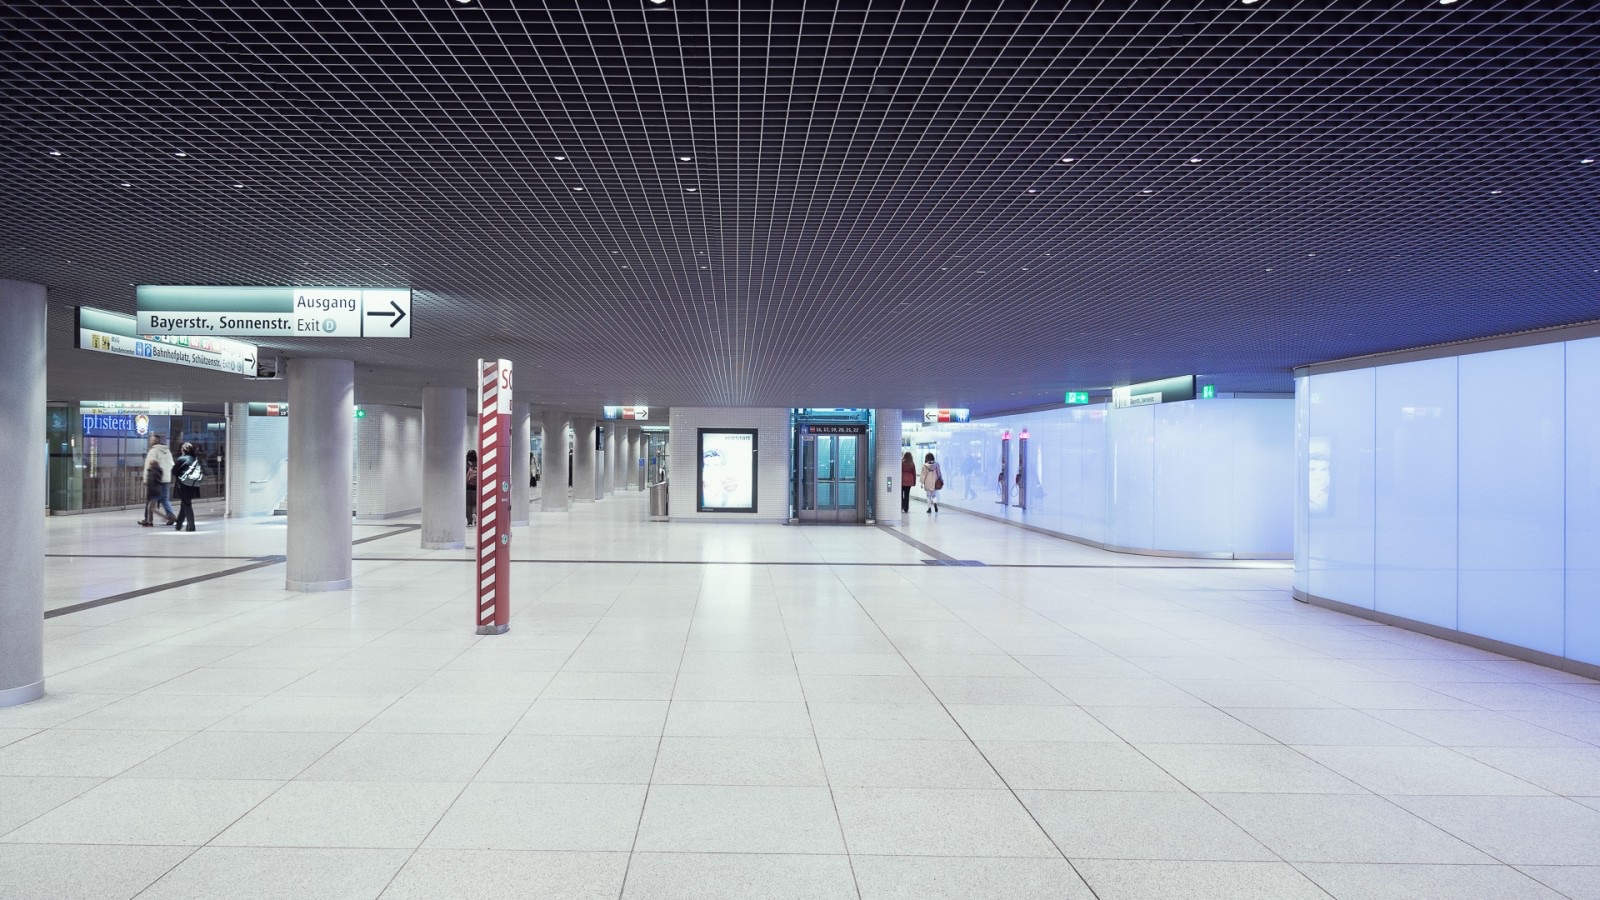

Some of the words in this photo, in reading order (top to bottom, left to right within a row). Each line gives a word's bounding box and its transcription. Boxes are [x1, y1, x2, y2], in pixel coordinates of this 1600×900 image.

[297, 295, 356, 311] Ausgang
[151, 315, 214, 331] Bayerstr.,
[219, 316, 292, 330] Sonnenstr.
[297, 319, 320, 332] Exit
[153, 347, 191, 364] Bahnhofplatz,
